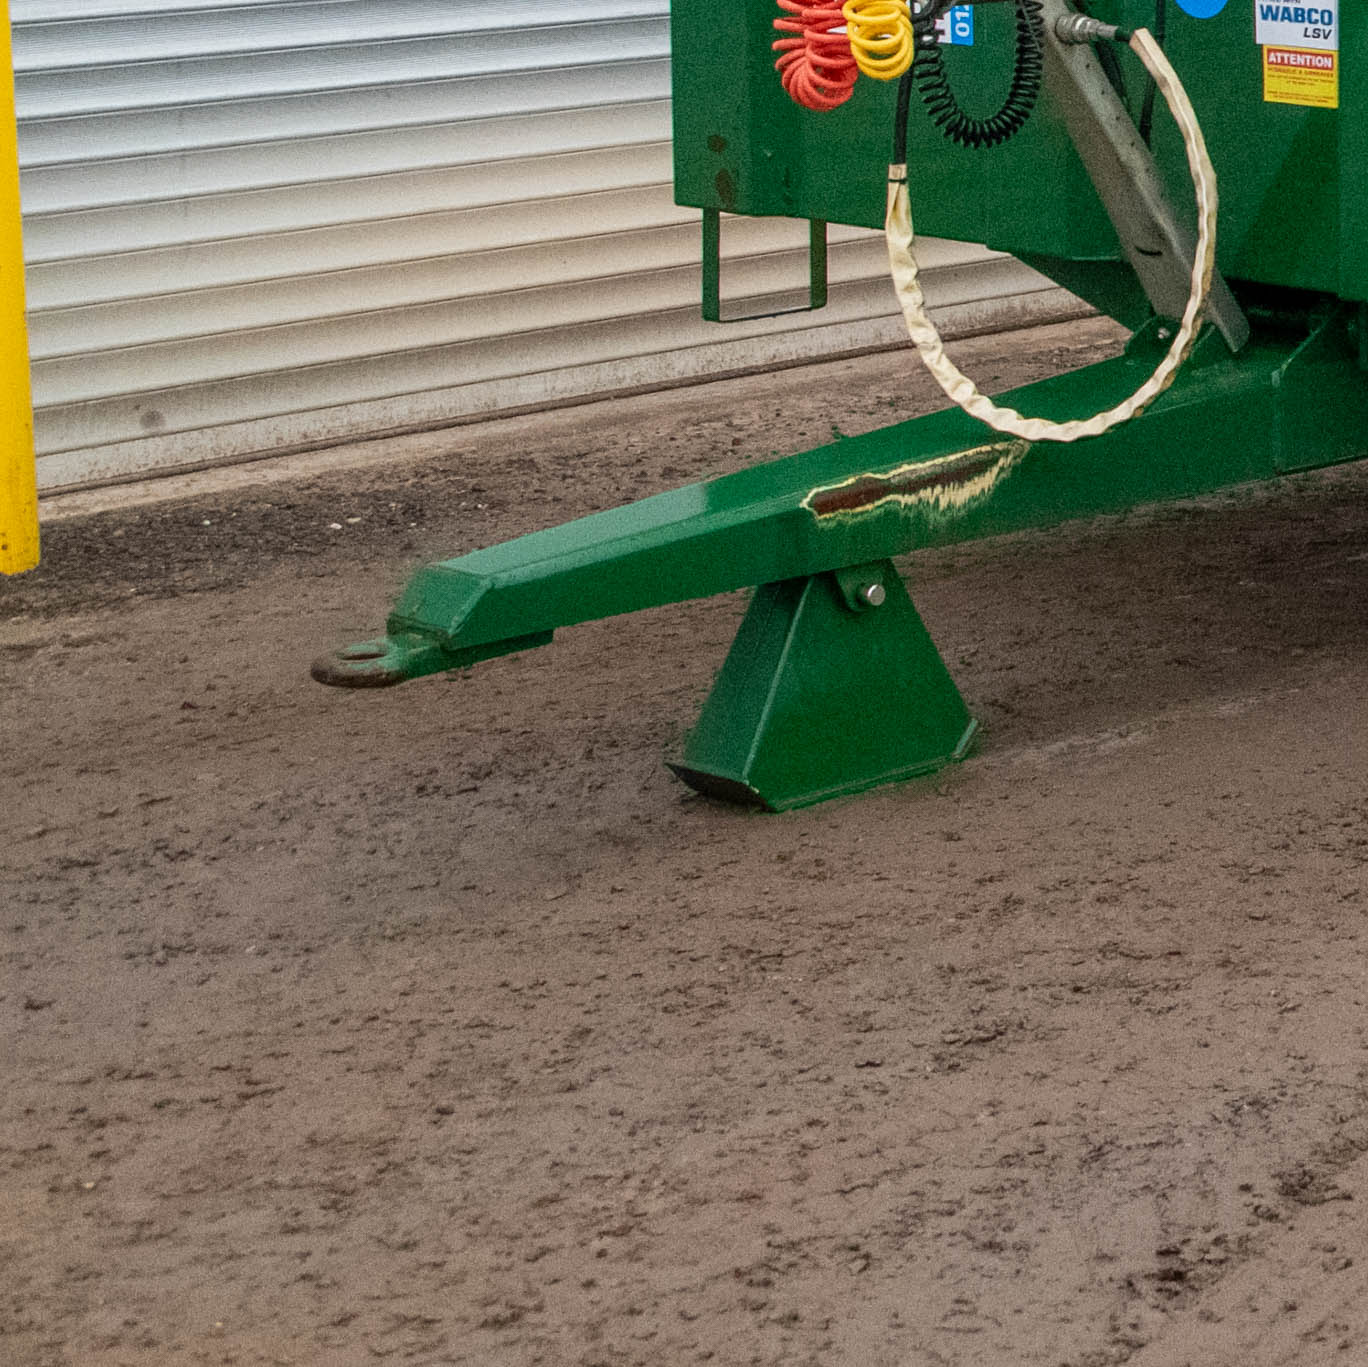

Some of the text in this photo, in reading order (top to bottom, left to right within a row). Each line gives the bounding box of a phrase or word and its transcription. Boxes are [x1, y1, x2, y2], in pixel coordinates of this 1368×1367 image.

[1259, 4, 1333, 26] WABCO
[1303, 27, 1332, 40] LSV
[1268, 51, 1333, 68] ATTENTION
